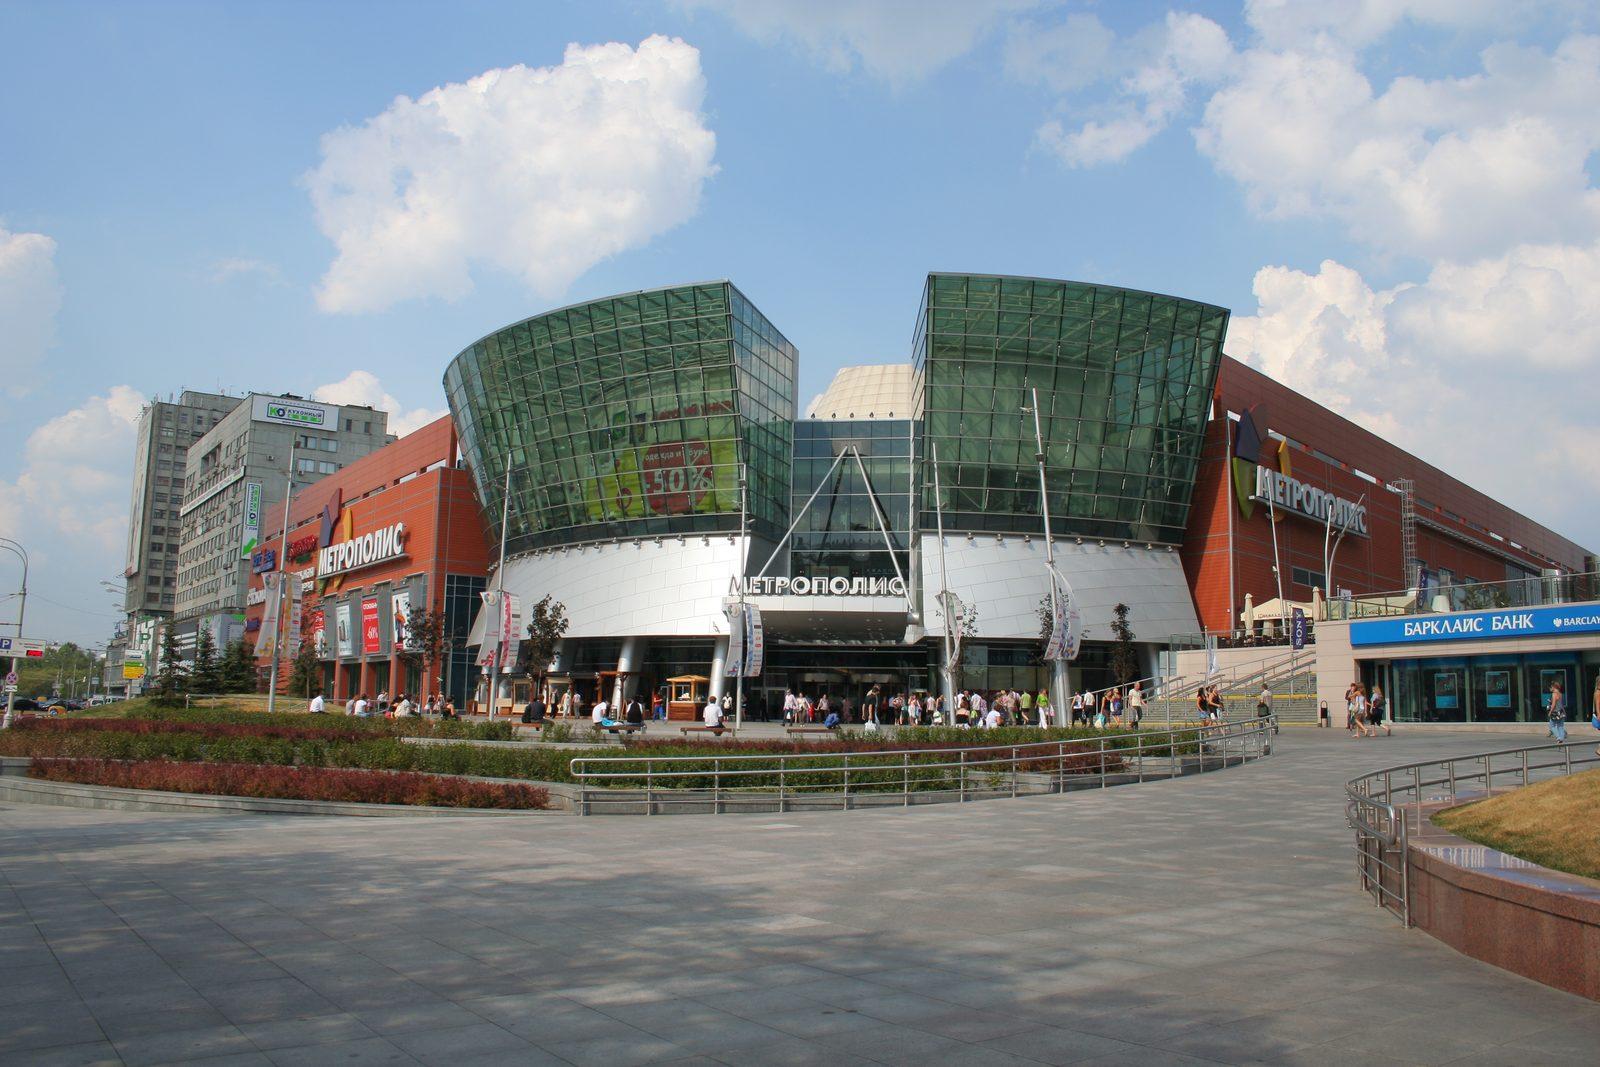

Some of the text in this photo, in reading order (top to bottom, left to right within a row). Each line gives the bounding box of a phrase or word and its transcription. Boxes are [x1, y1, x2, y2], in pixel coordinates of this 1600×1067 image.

[1256, 465, 1367, 533] МЕТРОПОЛИС
[318, 522, 404, 576] МЕТРОПОЛИС
[729, 574, 905, 596] МЕТРОПОЛИС
[1295, 611, 1303, 646] SONY
[1404, 614, 1534, 637] БАРКЛАЙС БАНК
